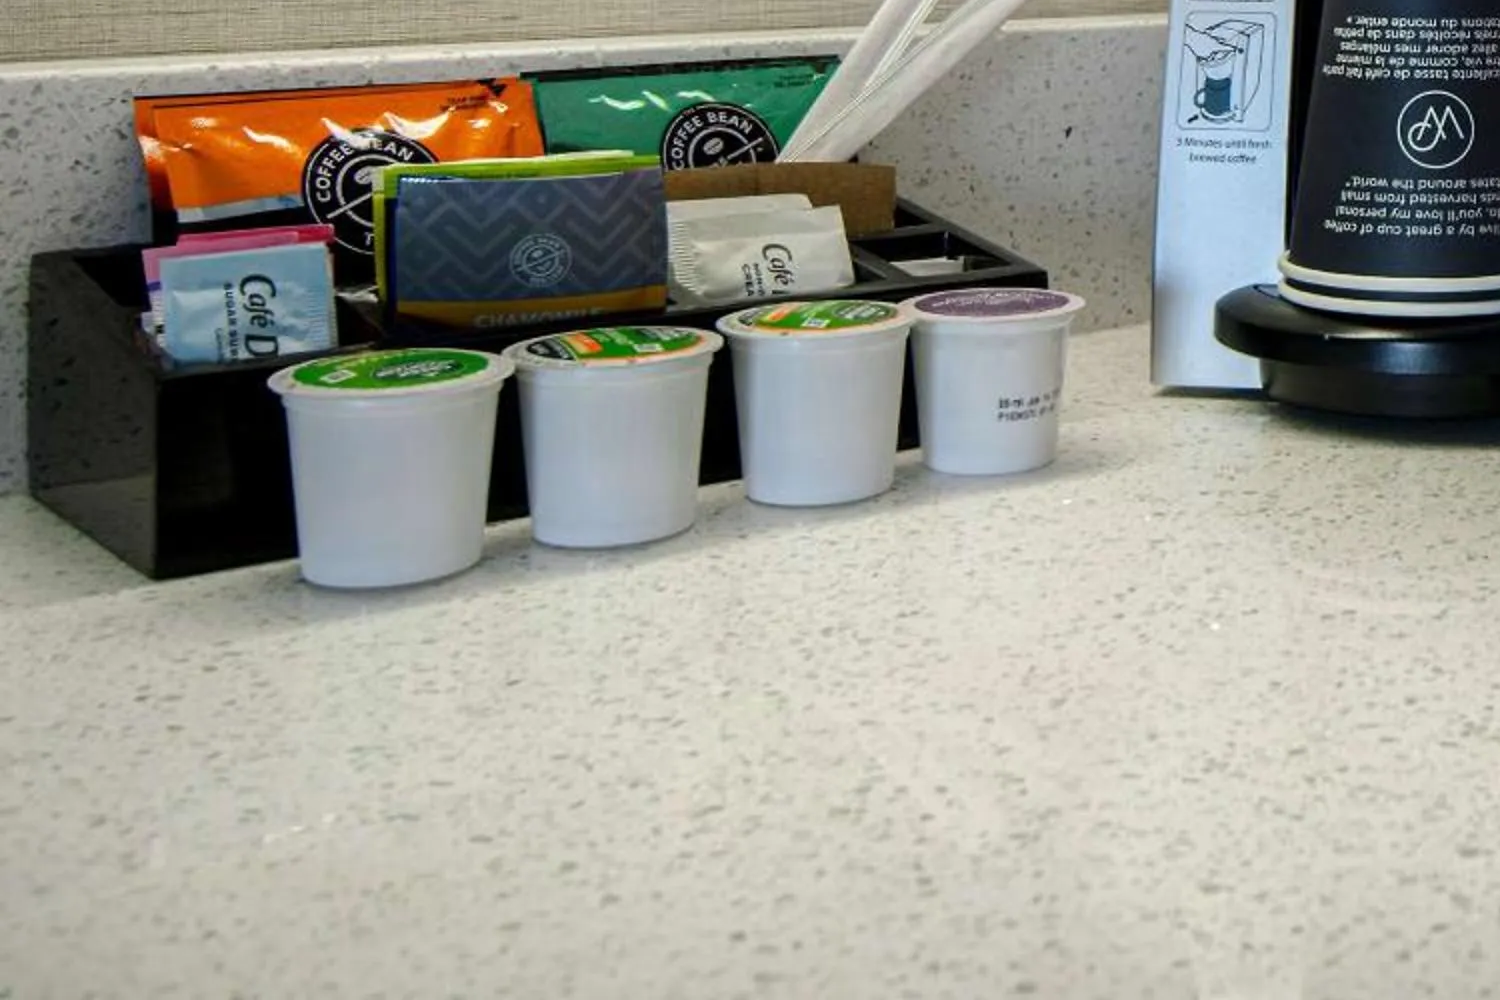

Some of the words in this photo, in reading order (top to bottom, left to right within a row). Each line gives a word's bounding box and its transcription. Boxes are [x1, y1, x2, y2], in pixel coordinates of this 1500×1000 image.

[1390, 17, 1437, 29] monde
[1441, 18, 1459, 30] du
[1394, 43, 1421, 53] mes
[1409, 56, 1459, 67] comme
[1414, 69, 1449, 80] tasse
[672, 114, 704, 171] COFFEE
[707, 111, 752, 135] BEAN
[316, 142, 353, 202] COFFEE
[1391, 178, 1415, 190] the
[1417, 179, 1467, 191] around
[1341, 190, 1371, 202] small
[1373, 193, 1405, 205] from
[1409, 193, 1478, 205] harvested
[1335, 205, 1387, 218] personal
[1391, 207, 1410, 219] my
[1415, 209, 1443, 221] love
[1447, 207, 1483, 222] you'll
[1359, 223, 1375, 236] of
[1377, 223, 1402, 235] cup
[1405, 223, 1443, 238] great
[1446, 225, 1455, 235] a
[1459, 223, 1476, 237] by
[240, 273, 277, 329] Café
